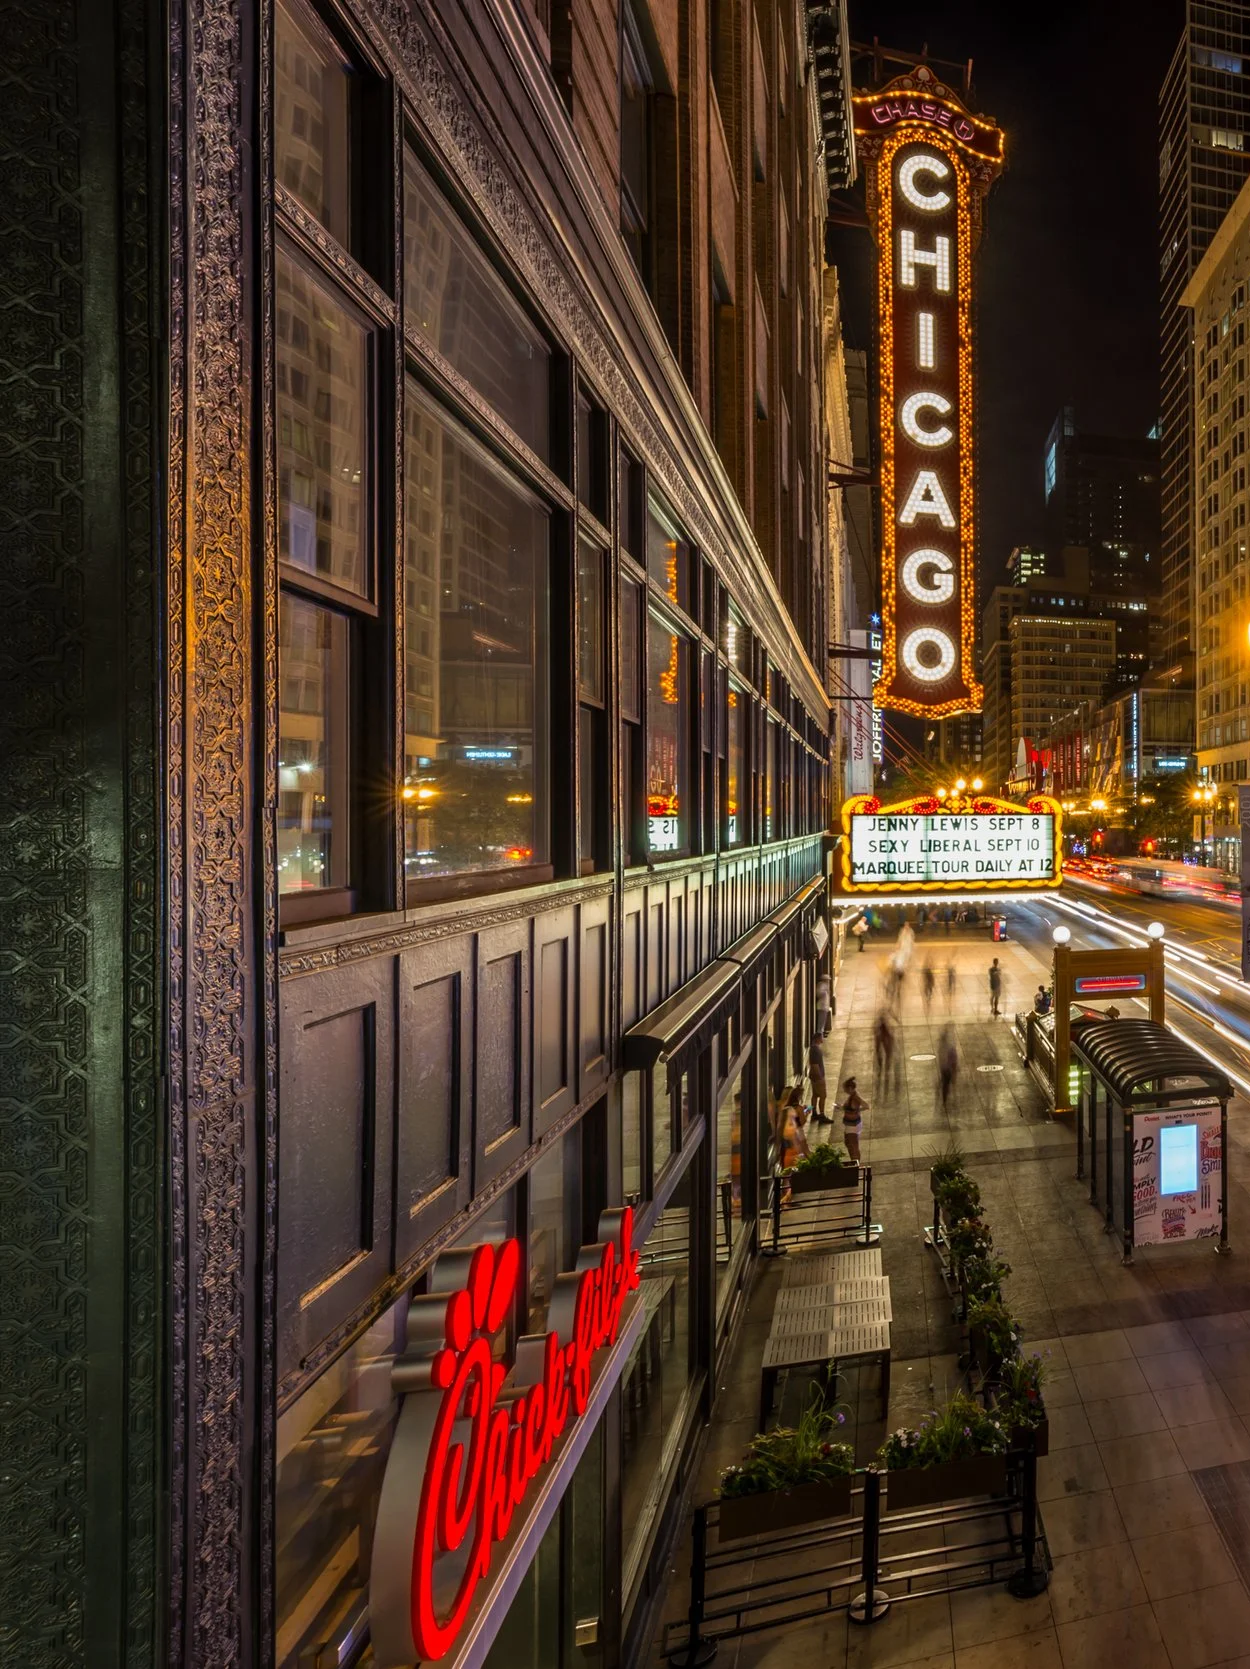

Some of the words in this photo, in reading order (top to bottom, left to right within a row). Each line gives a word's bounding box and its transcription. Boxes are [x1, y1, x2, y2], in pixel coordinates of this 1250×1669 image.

[871, 102, 952, 127] CHASE
[898, 154, 957, 682] CHICAGO
[871, 631, 882, 684] ALET
[868, 818, 919, 832] JENNY
[930, 818, 978, 832] LEWIS
[989, 817, 1023, 830] SEPT
[1031, 817, 1040, 830] 8
[868, 839, 909, 853] SEXY
[920, 839, 981, 853] LIBERAL
[987, 838, 1022, 851] SEPT
[1026, 838, 1040, 851] 10
[853, 860, 925, 875] MARQUEE
[932, 860, 970, 873] TOUR
[975, 859, 1013, 873] DAILY
[1018, 859, 1035, 872] AT
[1040, 859, 1053, 872] 12
[411, 1206, 640, 1661] Chick-fil-A
